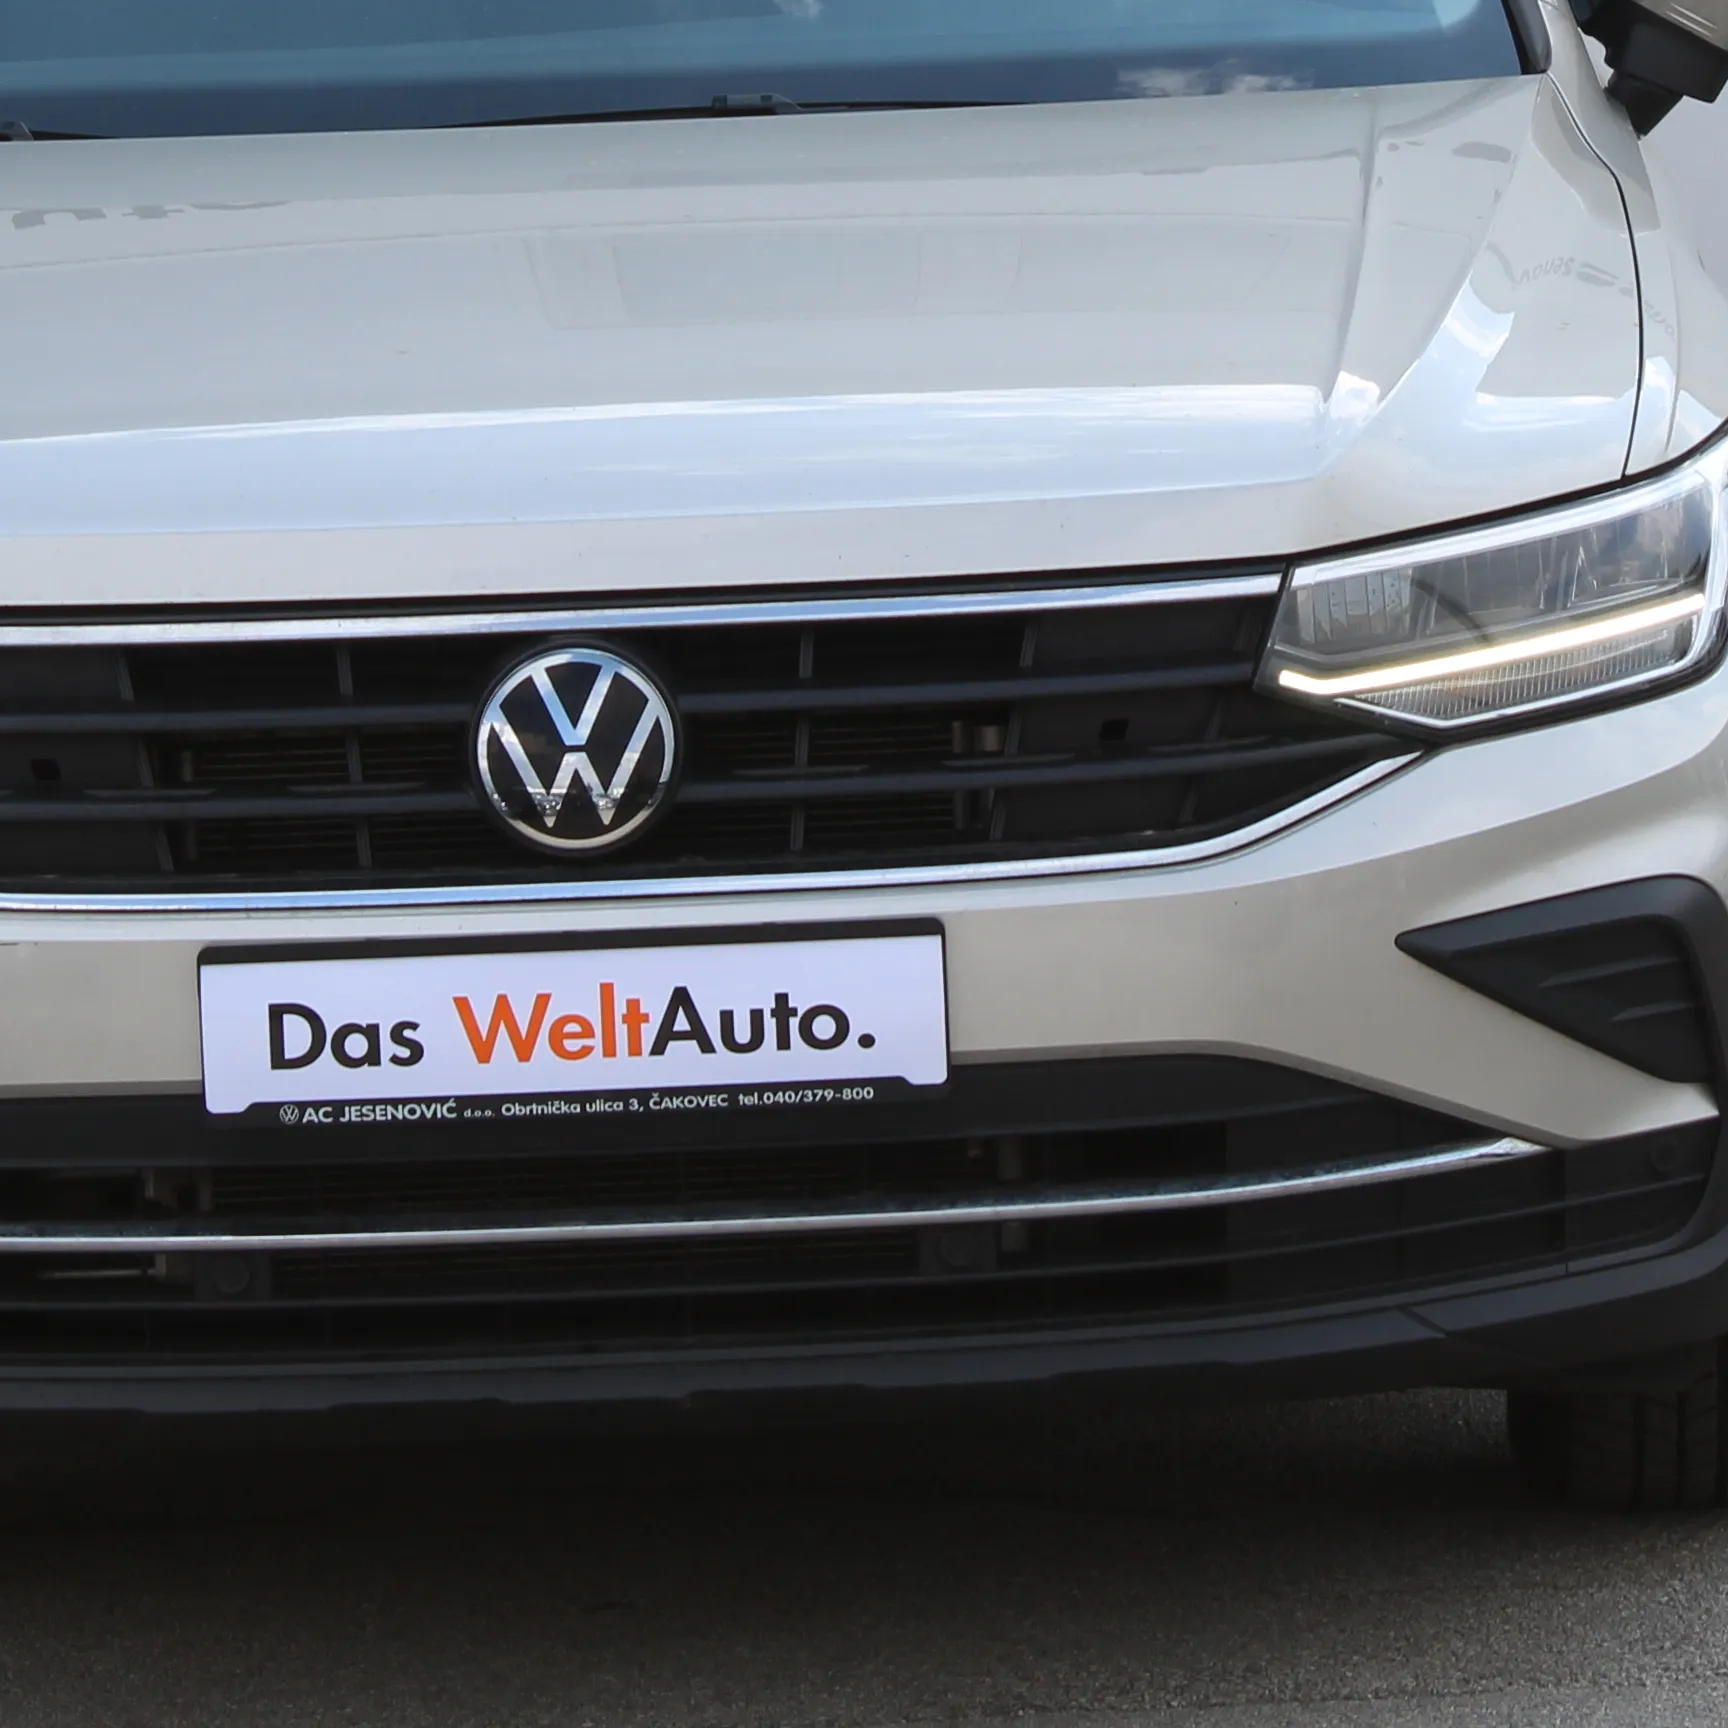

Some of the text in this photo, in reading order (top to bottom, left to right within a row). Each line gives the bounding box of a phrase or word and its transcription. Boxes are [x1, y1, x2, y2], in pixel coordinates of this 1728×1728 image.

[268, 983, 876, 1071] Das WeltAuto.
[302, 1106, 333, 1124] AC
[339, 1098, 457, 1123] JESENOVIĆ
[463, 1108, 495, 1119] d.o.o.
[501, 1100, 581, 1117] Obrtnička
[585, 1098, 623, 1114] ulica
[628, 1098, 644, 1112] 3,
[648, 1092, 729, 1110] ČAKOVEC
[738, 1086, 874, 1107] tel.040/379-800
